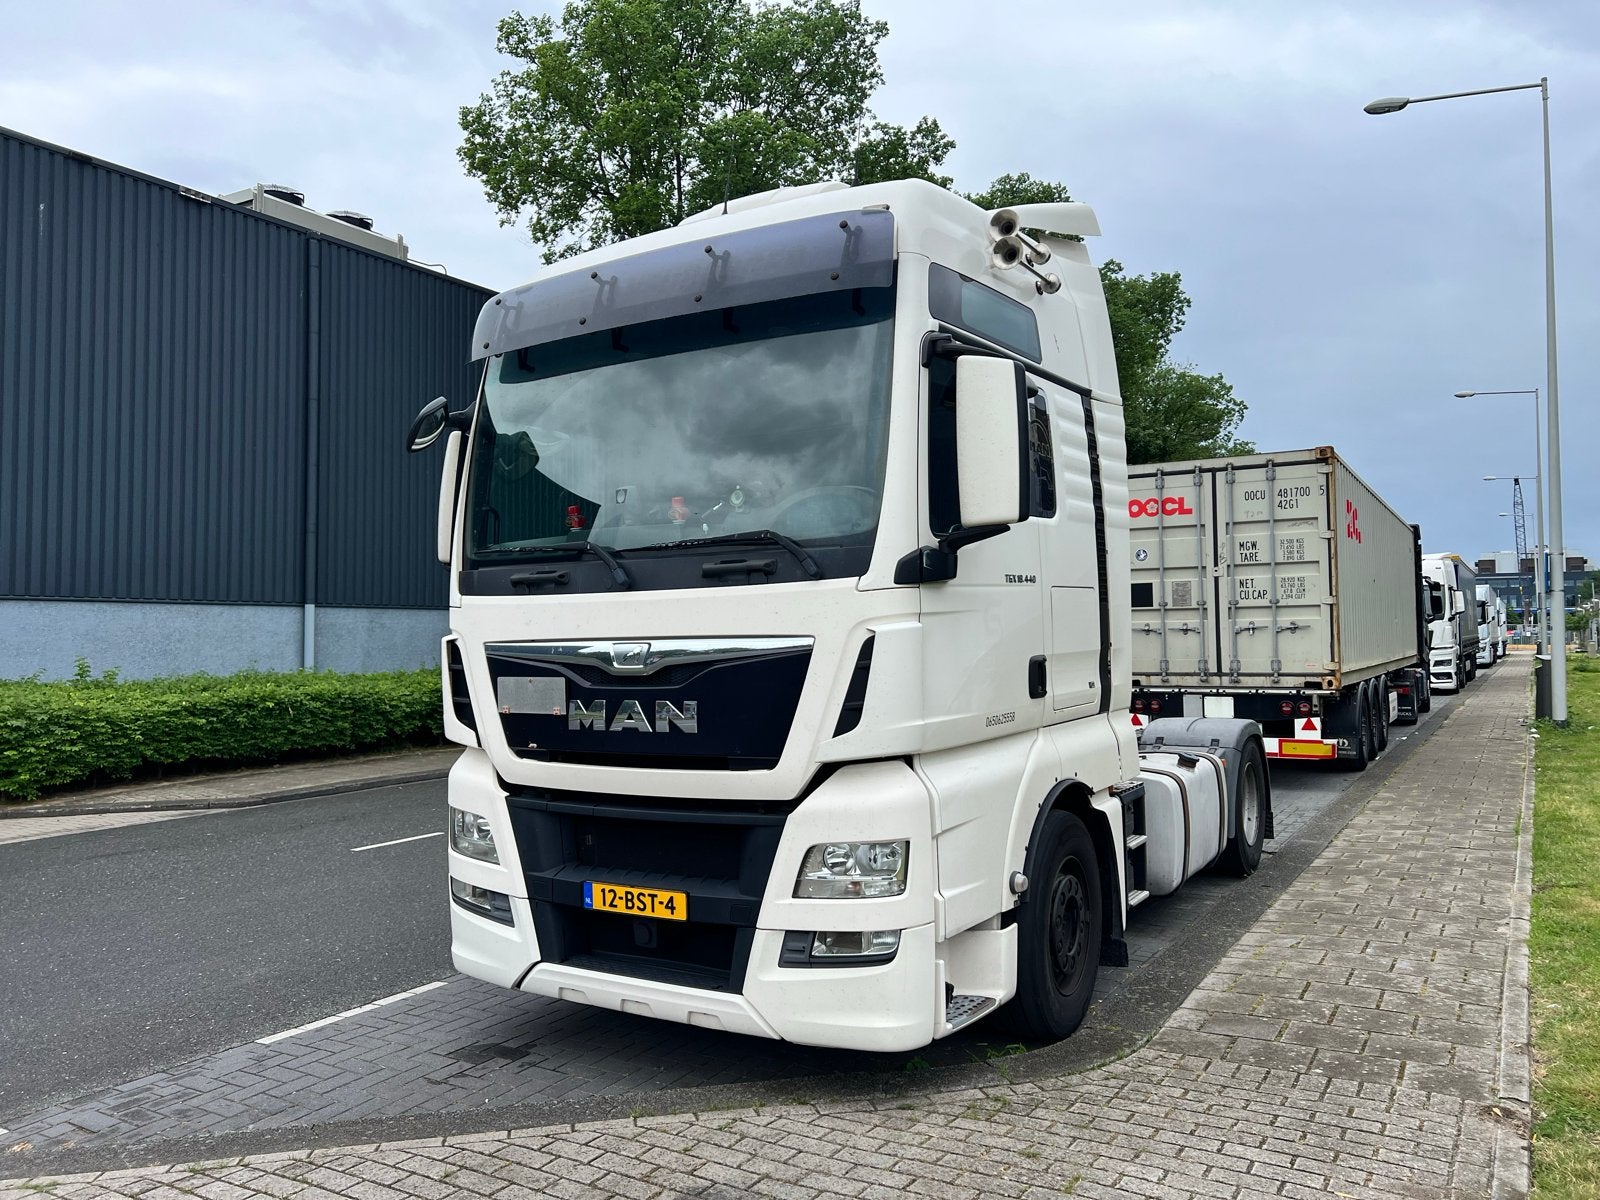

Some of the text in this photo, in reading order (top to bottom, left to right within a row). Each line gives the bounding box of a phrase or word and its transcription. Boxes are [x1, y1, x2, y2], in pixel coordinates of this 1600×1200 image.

[1244, 485, 1325, 501] OOCU 481700 5
[1128, 497, 1193, 518] OOCL
[1277, 499, 1299, 510] 42G1
[1239, 540, 1260, 552] MGW.
[1240, 552, 1262, 562] TARE.
[1239, 578, 1257, 589] NET.
[568, 699, 698, 733] MAN
[600, 887, 676, 916] 12-BST-4
